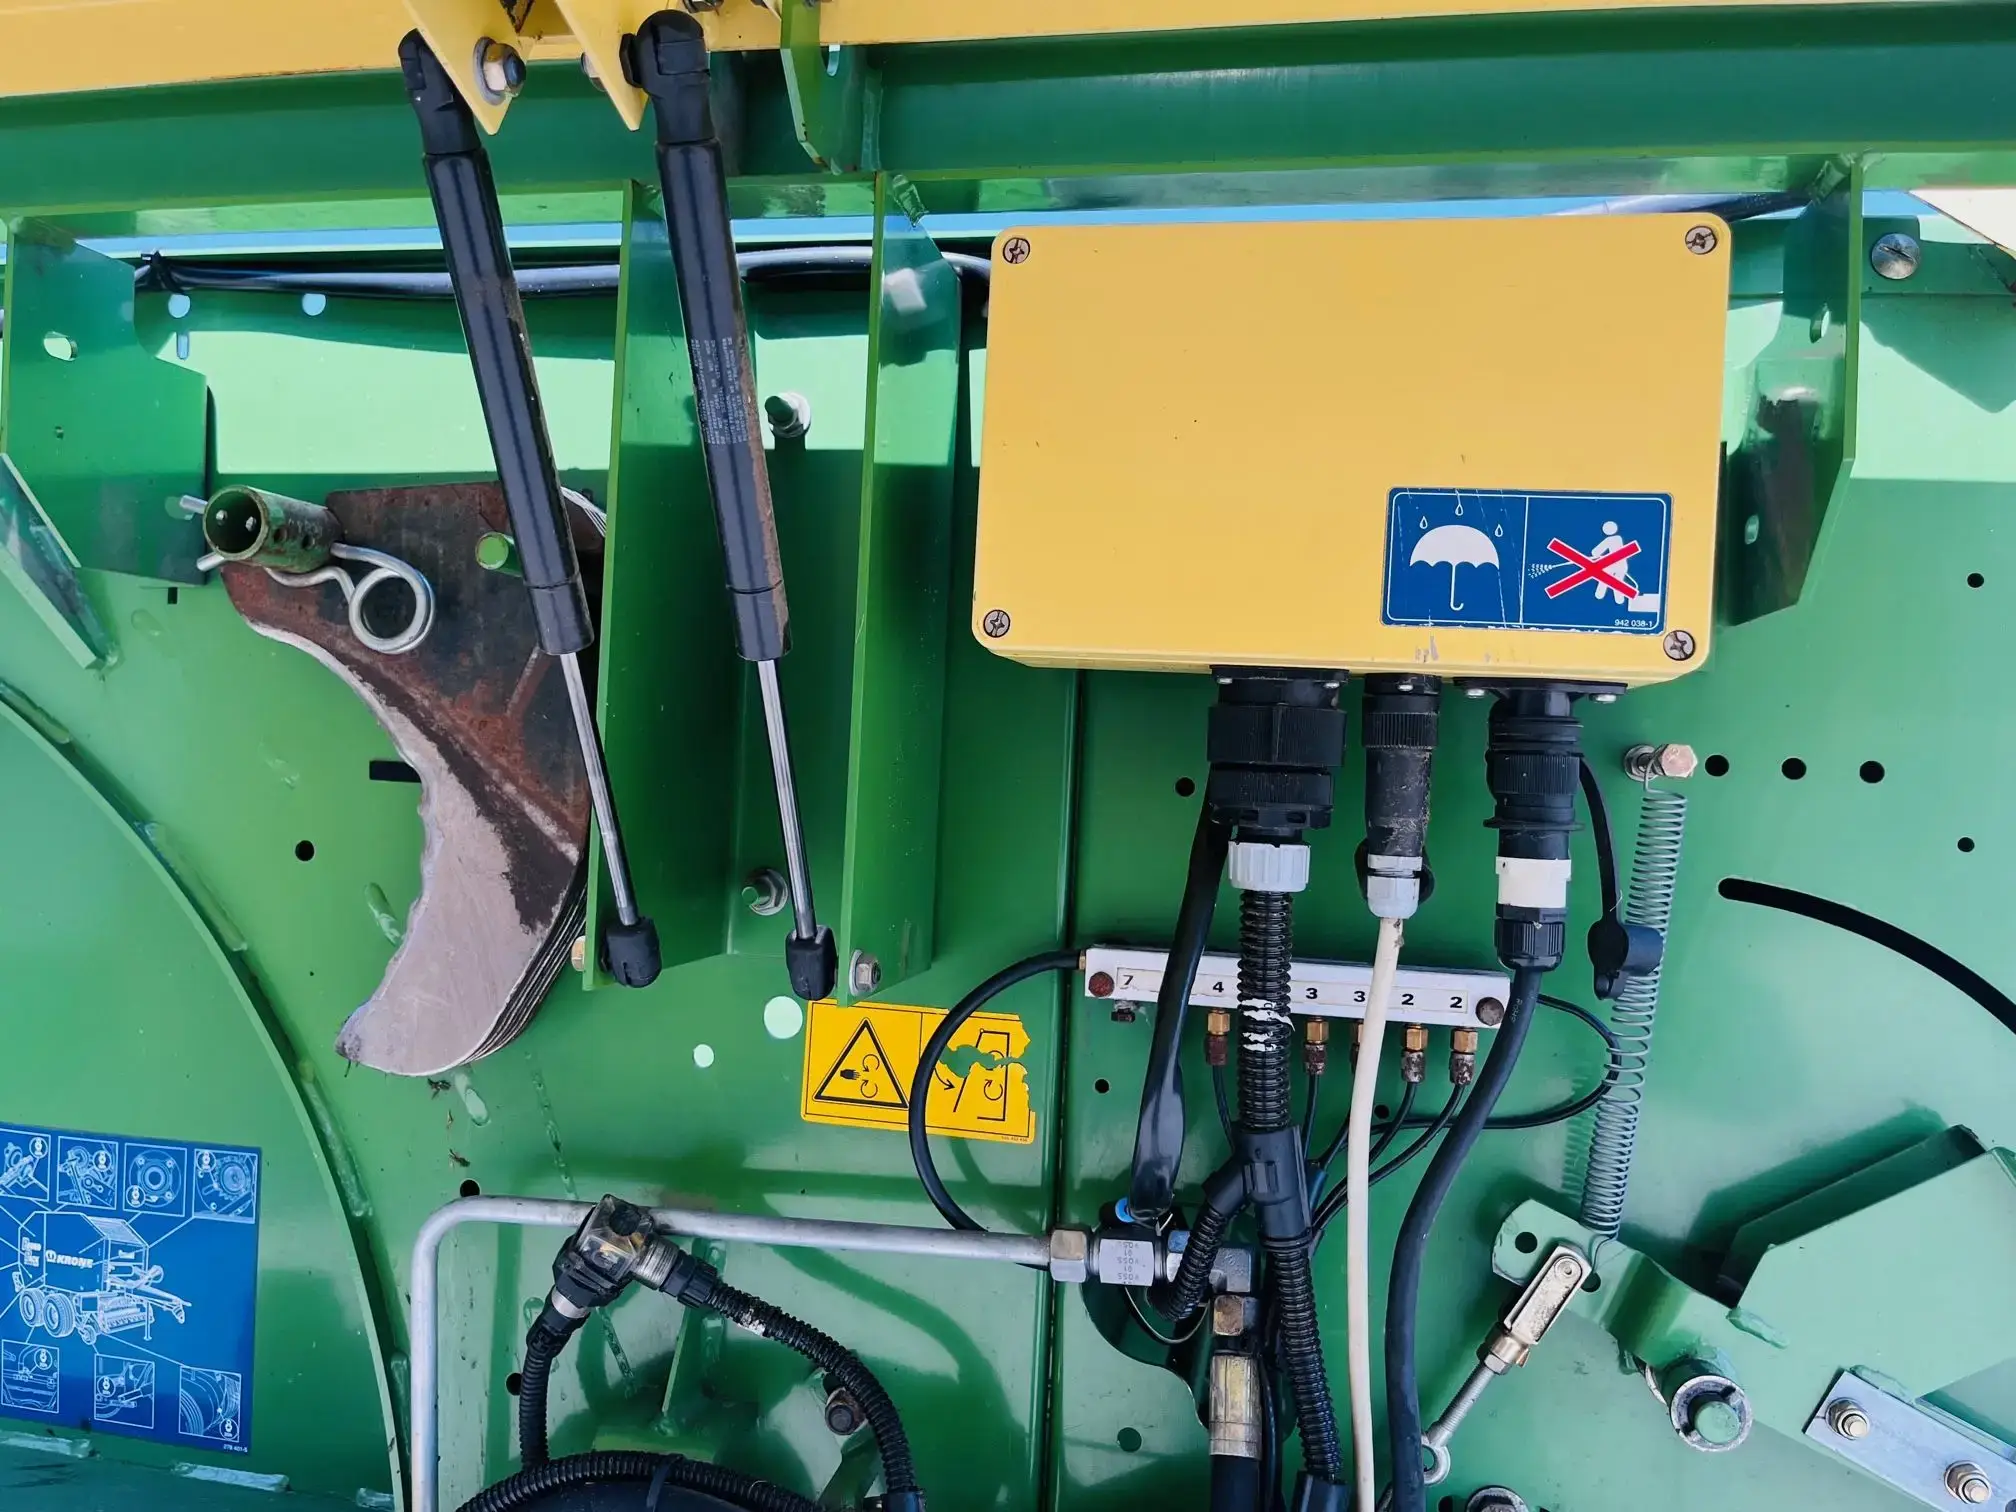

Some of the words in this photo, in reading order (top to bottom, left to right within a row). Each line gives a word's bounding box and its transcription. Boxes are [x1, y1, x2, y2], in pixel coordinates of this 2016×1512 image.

[1614, 619, 1629, 627] 942
[1630, 619, 1653, 628] 038-1
[1122, 974, 1134, 986] 7
[1212, 981, 1225, 993] 4
[1305, 987, 1318, 1000] 3
[1353, 990, 1366, 1003] 3
[1401, 993, 1415, 1006] 2
[1449, 996, 1463, 1009] 2
[56, 1253, 94, 1269] KRONE
